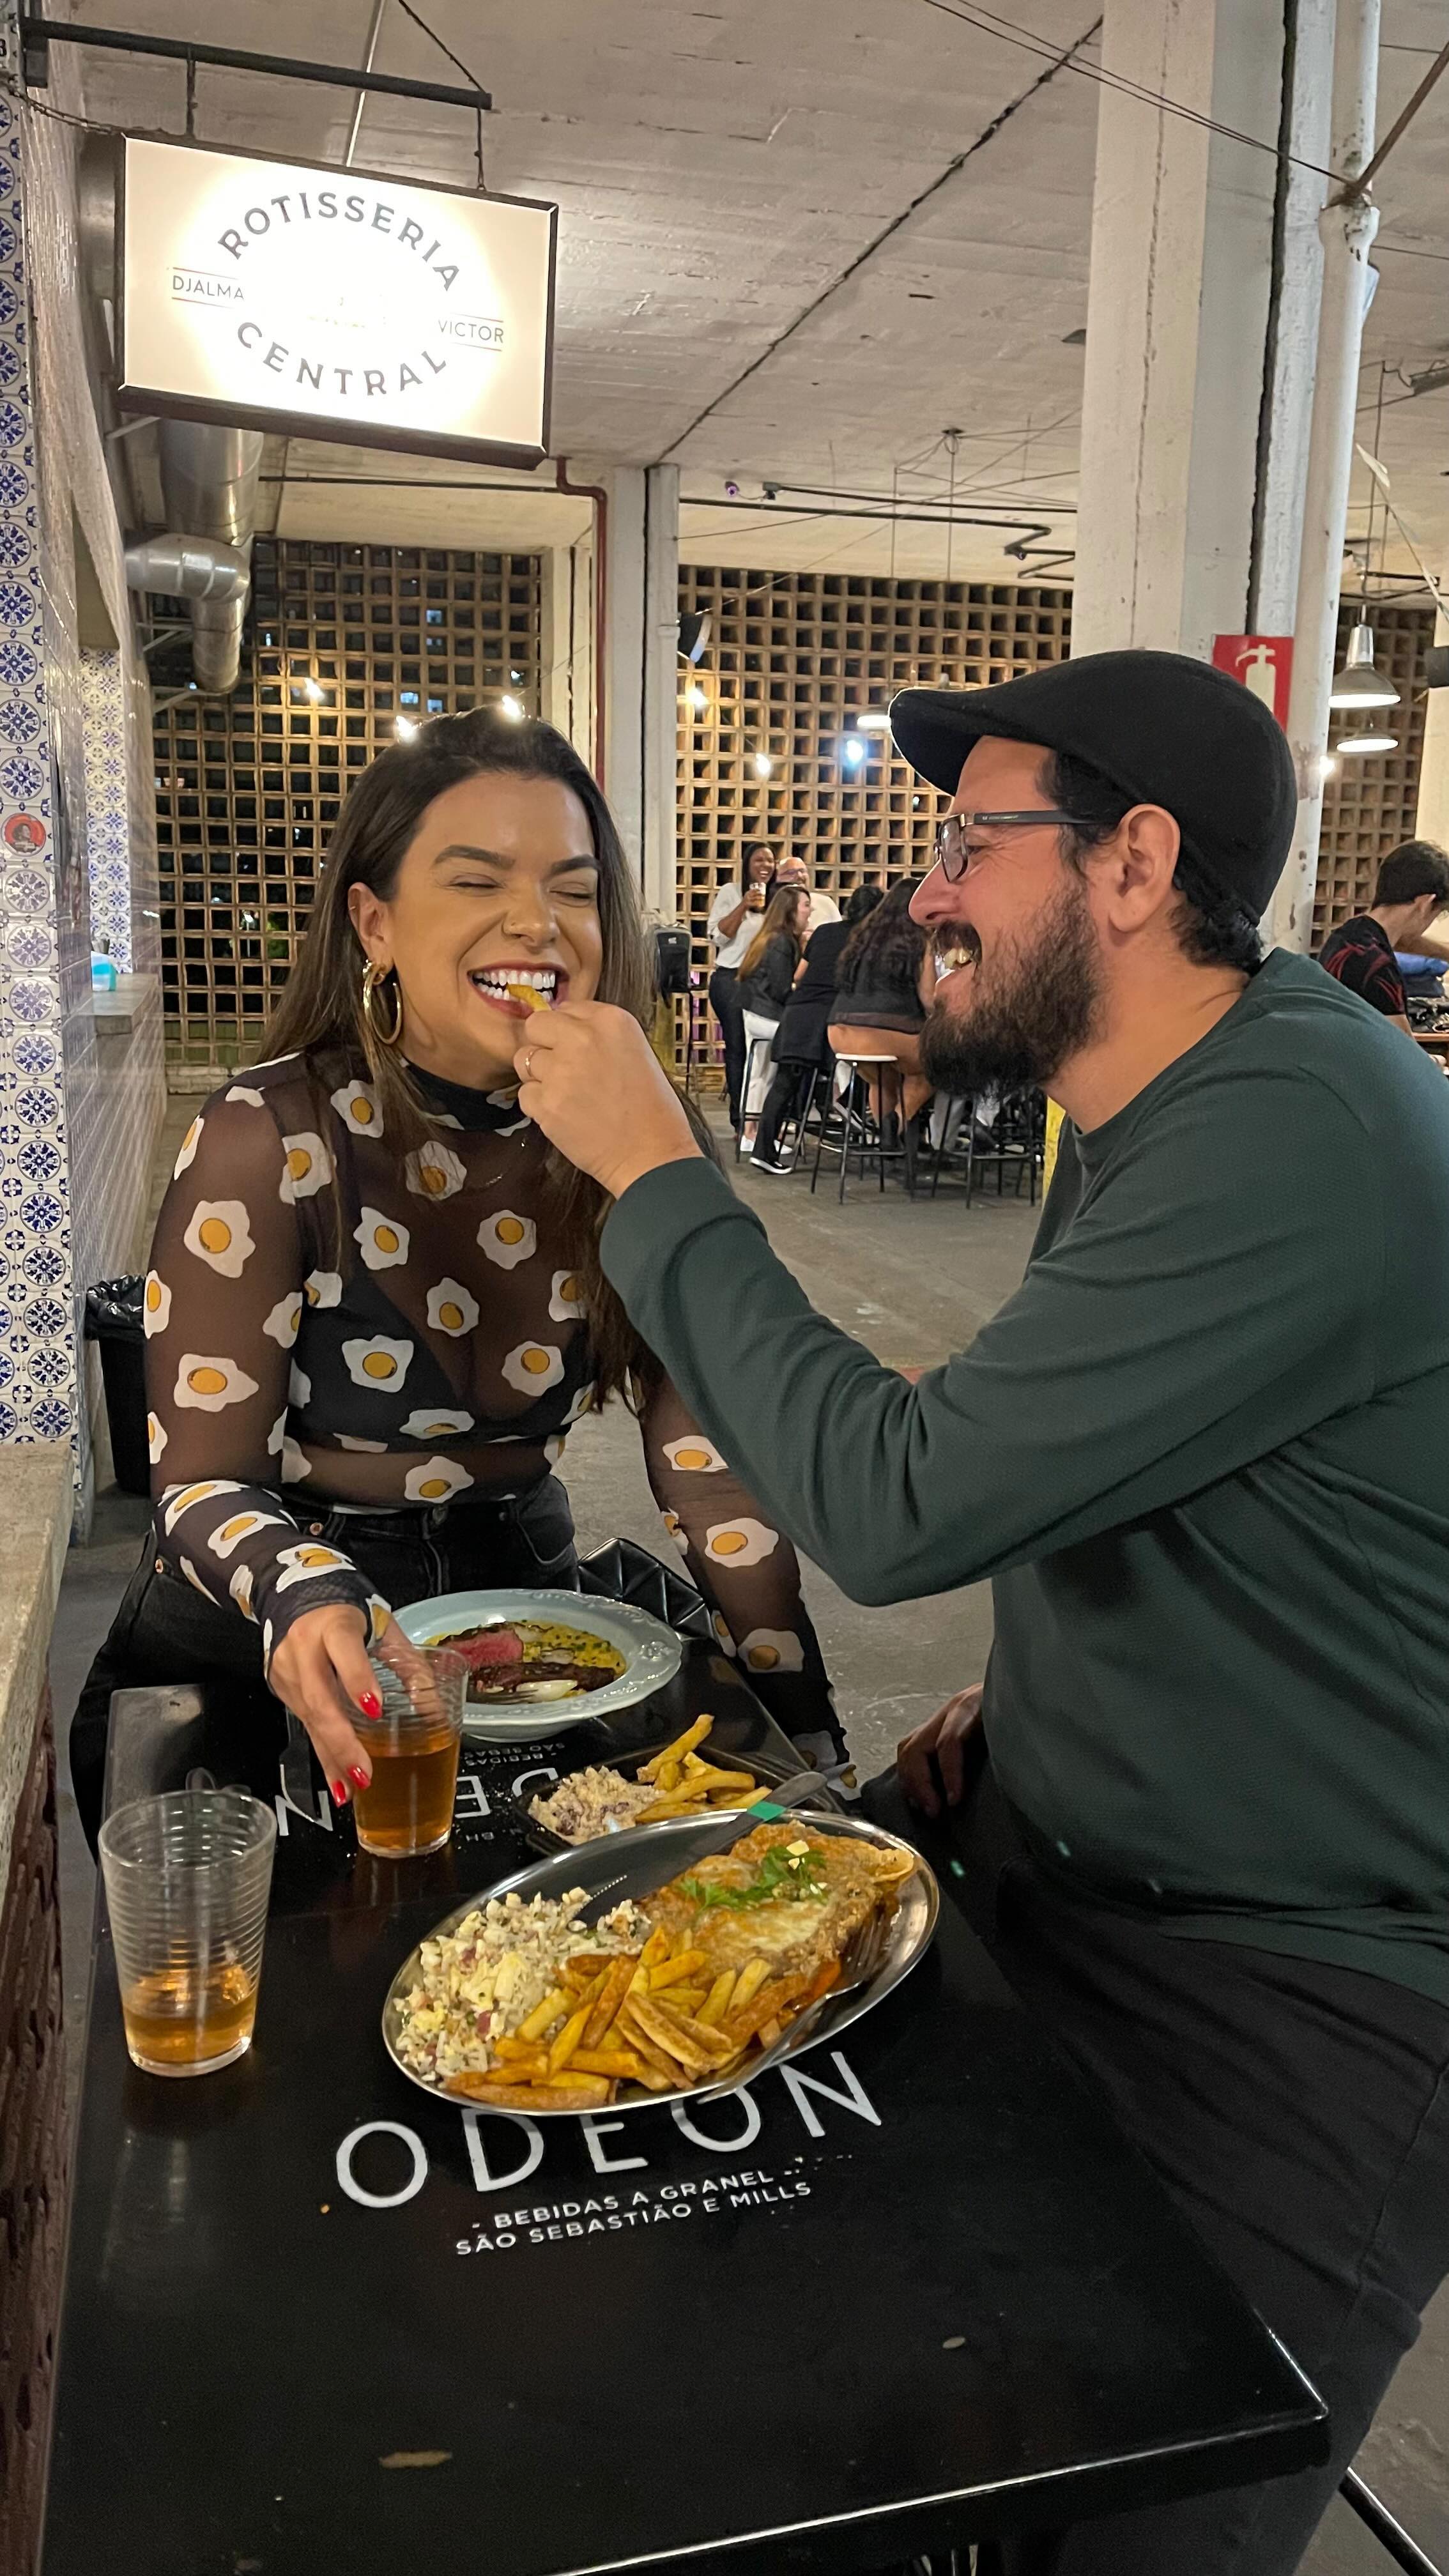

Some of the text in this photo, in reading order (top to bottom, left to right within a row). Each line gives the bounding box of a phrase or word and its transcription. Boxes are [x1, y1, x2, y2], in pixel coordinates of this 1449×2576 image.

[218, 192, 459, 292] ROTISSERIA
[172, 274, 245, 301] DJALMA
[237, 321, 447, 396] CENTRAL
[438, 319, 505, 344] VICTOR
[335, 2051, 882, 2209] ODEON
[456, 2182, 811, 2255] SÃO SEBASTIÃO E MILLS
[494, 2196, 619, 2229] BEBIDAS
[632, 2191, 650, 2205] A
[660, 2170, 774, 2200] GRANEL
